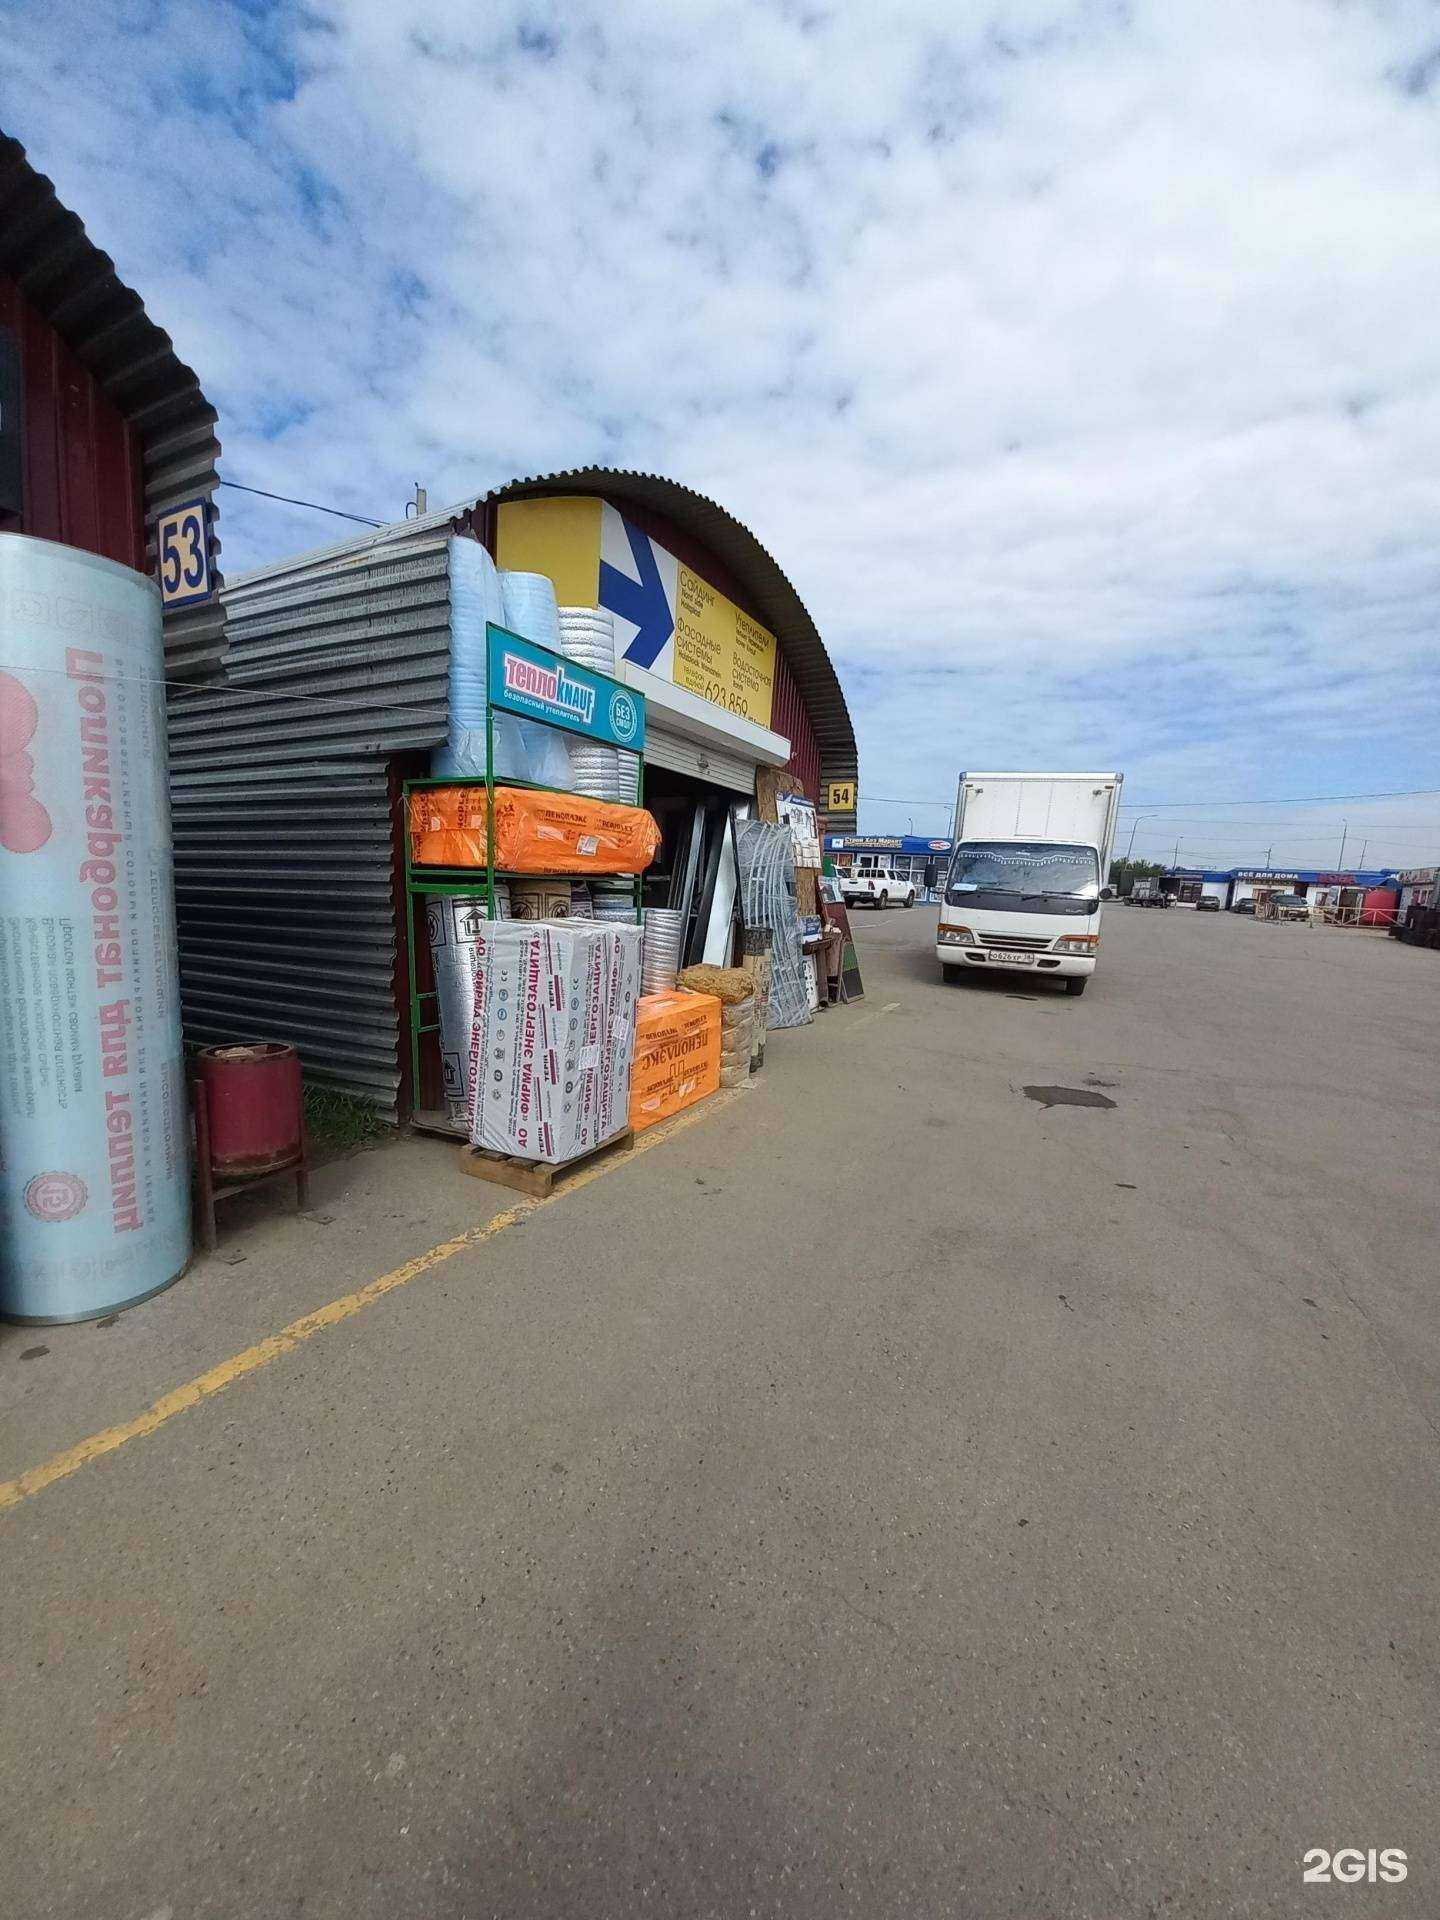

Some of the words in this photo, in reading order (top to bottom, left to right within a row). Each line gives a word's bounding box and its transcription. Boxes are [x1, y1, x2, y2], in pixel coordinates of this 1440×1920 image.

[162, 515, 205, 594] 53
[681, 570, 714, 607] Сайдинг
[677, 617, 721, 656] Фасадные
[735, 611, 769, 648] Утеплители
[732, 651, 771, 687] Водосточная
[503, 689, 545, 711] безопасный
[545, 703, 581, 723] утеплитель
[615, 702, 630, 720] БЕЗ
[833, 788, 850, 805] 54
[475, 936, 486, 956] АО
[614, 935, 620, 954] АО
[523, 931, 541, 1059] ЭНЕРГОЗАЩИТА»
[520, 1063, 533, 1122] «ФИРМА
[518, 1128, 528, 1148] АО
[581, 1128, 588, 1145] АО
